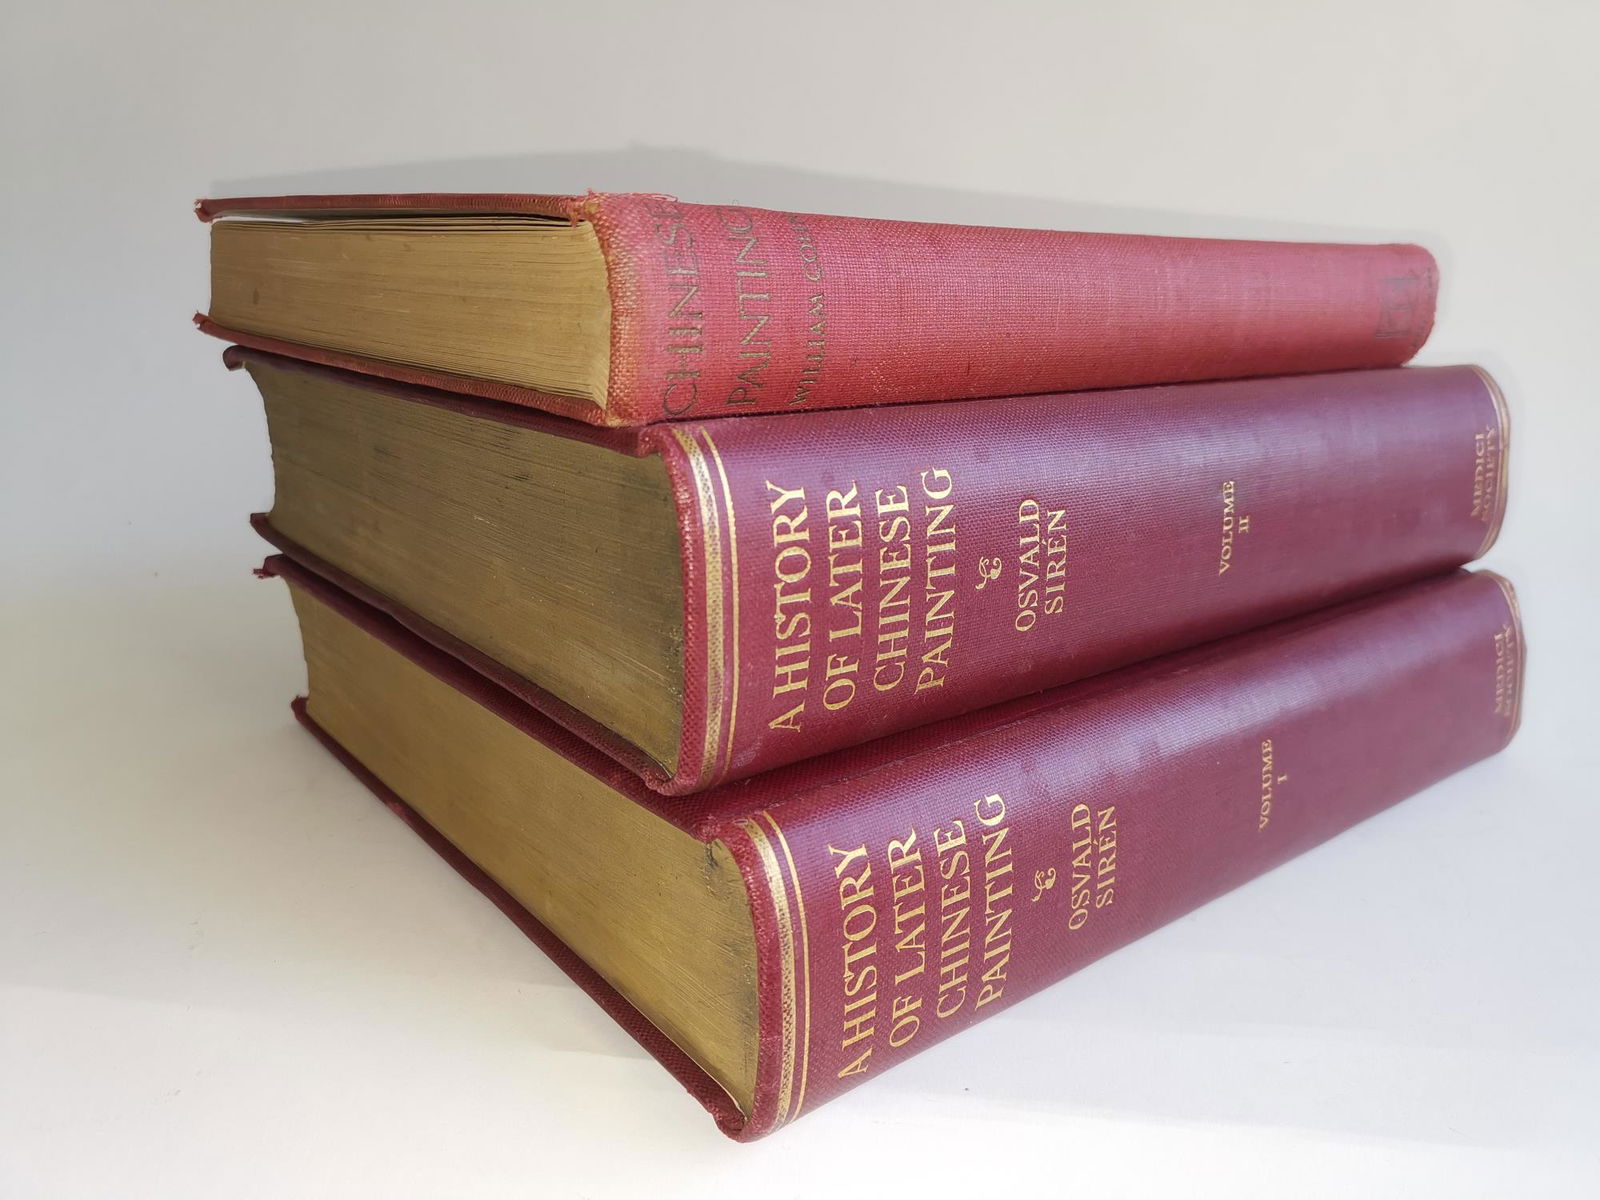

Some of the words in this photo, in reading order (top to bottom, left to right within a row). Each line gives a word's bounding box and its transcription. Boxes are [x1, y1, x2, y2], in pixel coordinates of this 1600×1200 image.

[644, 199, 703, 416] CHINESE
[789, 293, 826, 406] WILLIAM
[1219, 481, 1235, 576] VOLUME
[1238, 515, 1250, 533] II
[1470, 433, 1485, 517] MEDICI
[766, 480, 812, 699] HISTORY
[825, 480, 863, 642] LATER
[873, 486, 912, 691] CHINESE
[913, 467, 956, 695] PAINTING
[1015, 499, 1041, 632] OSVALD
[1041, 509, 1067, 614] SIRÉN
[768, 701, 805, 733] A
[823, 654, 860, 711] OF
[1259, 739, 1273, 832] VOLUME
[1277, 773, 1288, 785] I
[888, 827, 926, 985] LATER
[974, 794, 1013, 1011] PAINTING
[1068, 803, 1092, 930] OSVALD
[1092, 806, 1117, 908] SIRÉN
[828, 843, 877, 1051] HISTORY
[934, 820, 972, 1018] CHINESE
[837, 1047, 873, 1079] A
[889, 996, 922, 1048] OF
